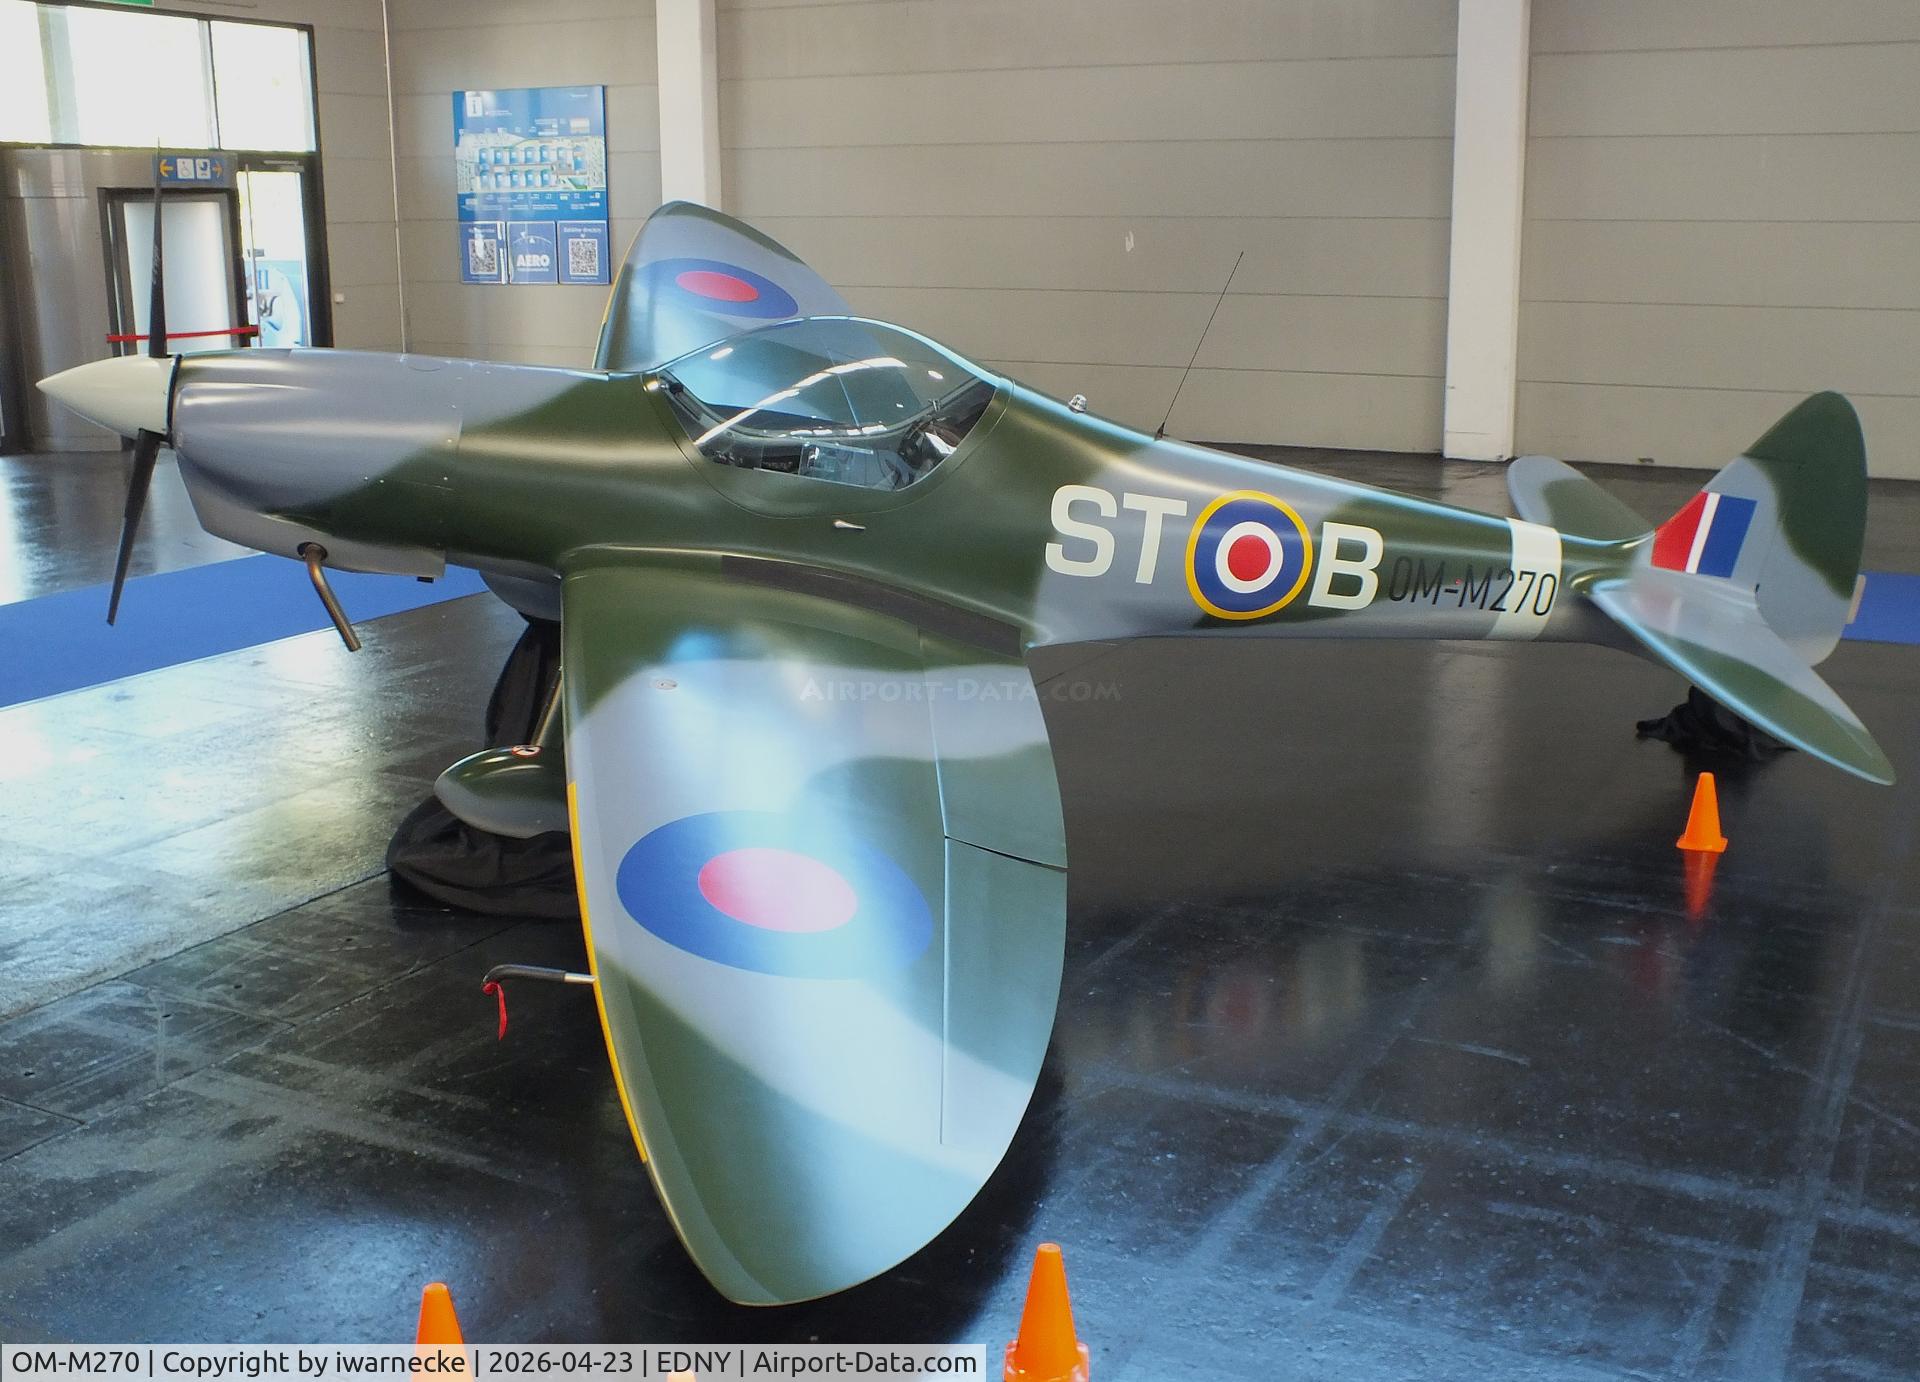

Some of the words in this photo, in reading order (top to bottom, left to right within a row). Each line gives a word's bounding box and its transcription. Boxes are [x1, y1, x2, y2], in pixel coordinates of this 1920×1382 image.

[516, 254, 550, 267] AERO
[1045, 485, 1188, 584] ST
[1308, 522, 1384, 610] B
[1389, 556, 1557, 616] OM-M270
